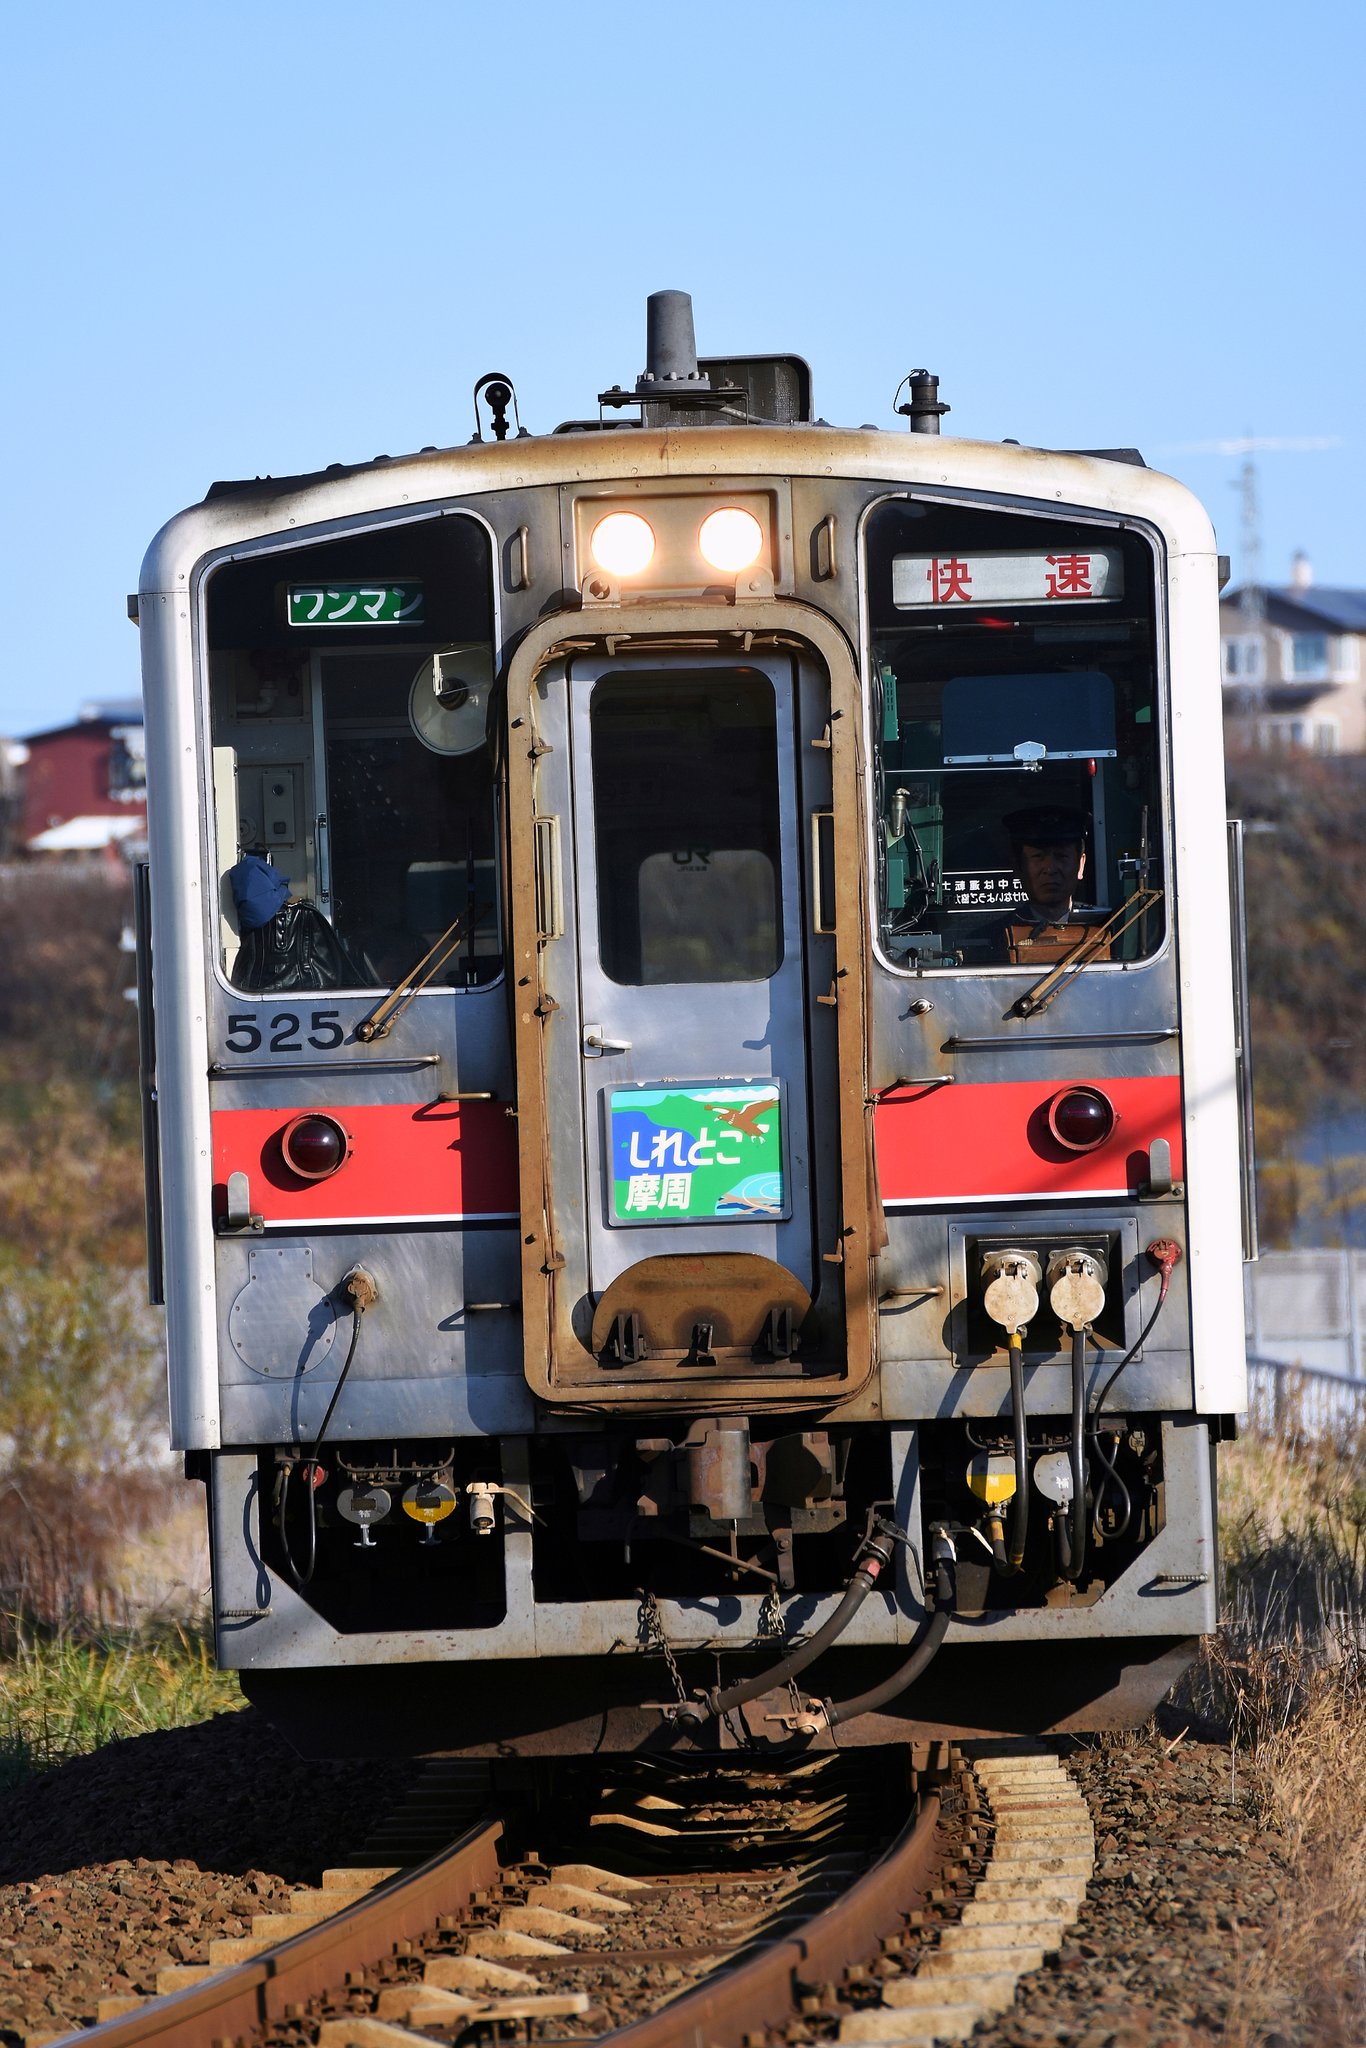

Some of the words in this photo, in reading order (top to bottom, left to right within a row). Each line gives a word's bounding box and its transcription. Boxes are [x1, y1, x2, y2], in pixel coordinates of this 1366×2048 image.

[926, 553, 1093, 603] 快速
[293, 587, 423, 620] ワンマン
[225, 1010, 344, 1053] 525
[629, 1127, 743, 1168] しれとこ
[624, 1172, 693, 1212] 摩周
